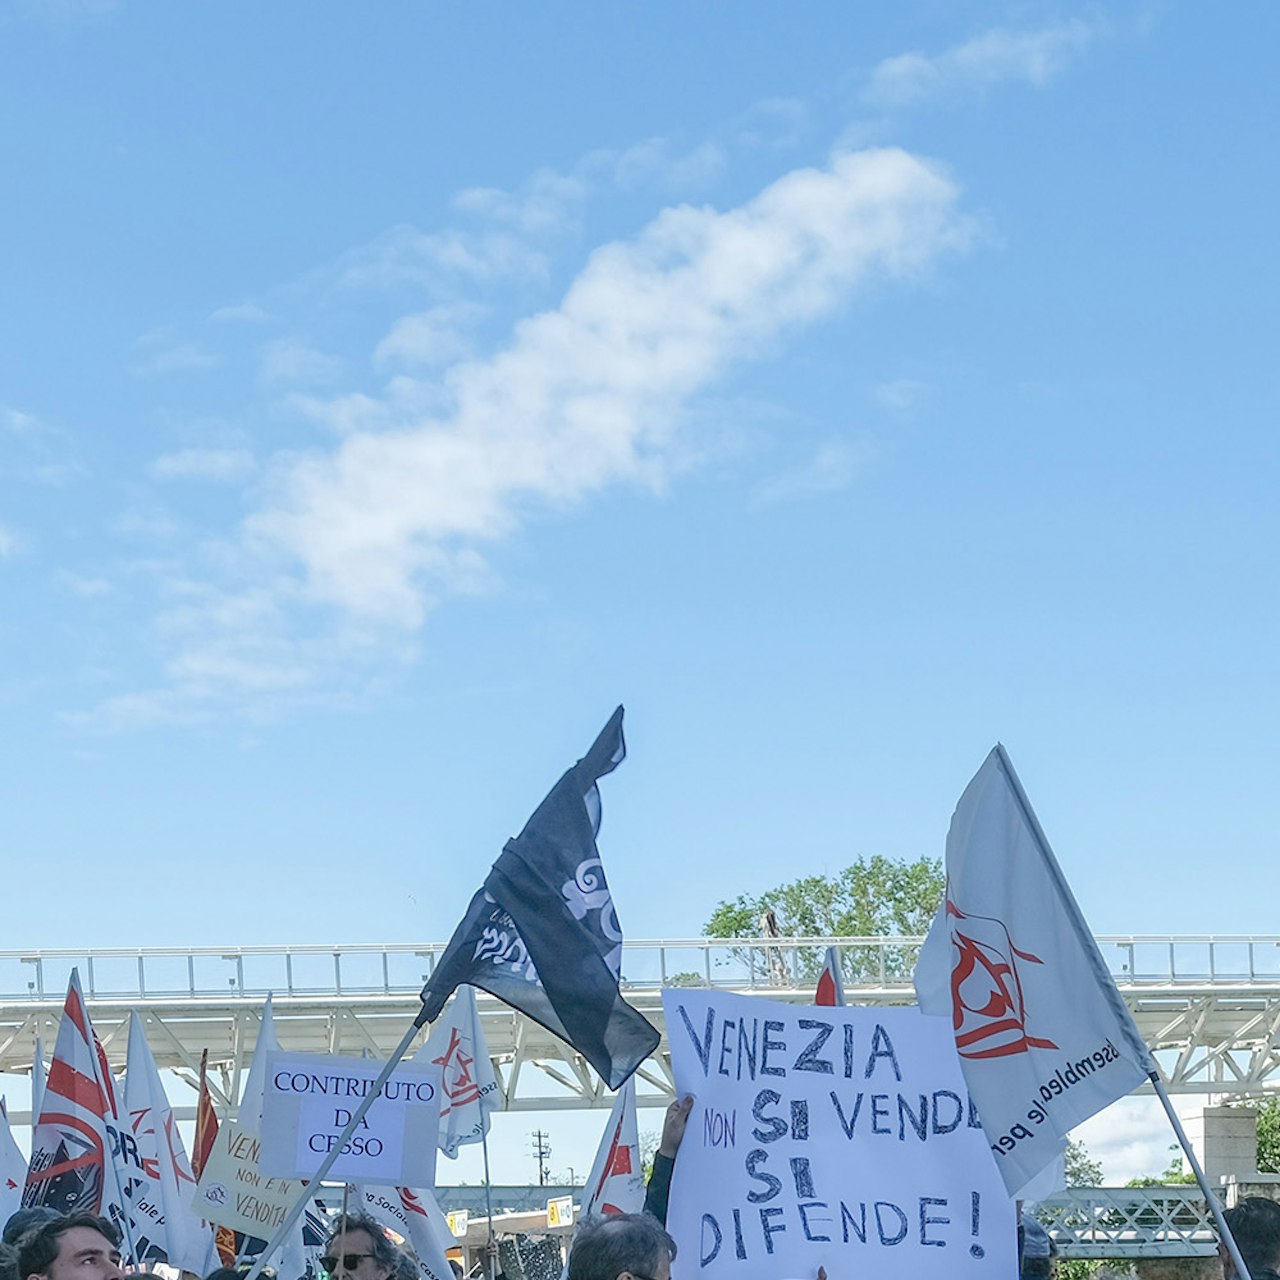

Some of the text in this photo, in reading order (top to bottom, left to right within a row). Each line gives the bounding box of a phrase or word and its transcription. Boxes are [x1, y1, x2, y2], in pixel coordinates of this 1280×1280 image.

[677, 1005, 902, 1081] VENEZIA
[703, 1108, 737, 1149] NON
[751, 1088, 809, 1144] SI
[236, 1167, 261, 1187] NON
[745, 1149, 816, 1203] SI
[236, 1193, 288, 1228] VENDITA
[701, 1191, 986, 1268] DIFENDE!
